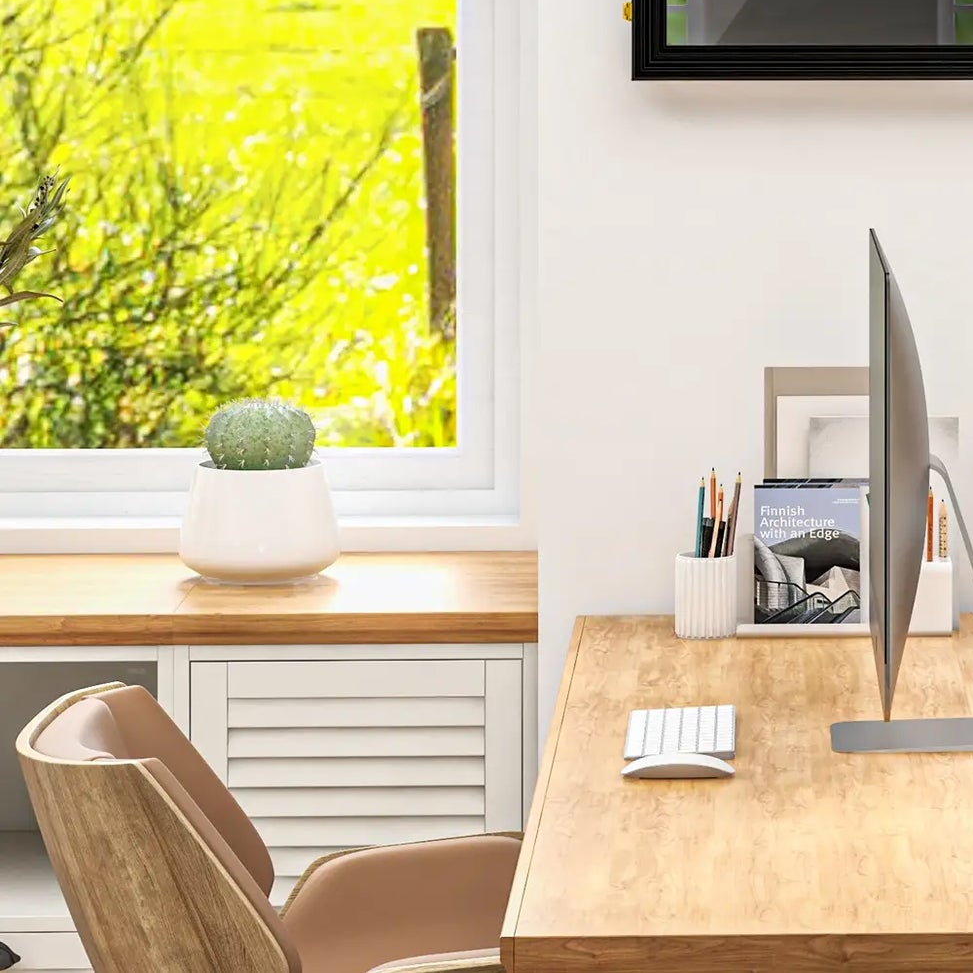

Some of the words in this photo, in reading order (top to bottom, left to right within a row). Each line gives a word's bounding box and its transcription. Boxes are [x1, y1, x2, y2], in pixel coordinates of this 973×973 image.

[760, 505, 805, 516] Finnish
[759, 517, 835, 527] Architecture
[759, 528, 787, 538] with
[790, 530, 806, 538] an
[809, 528, 840, 540] Edge
